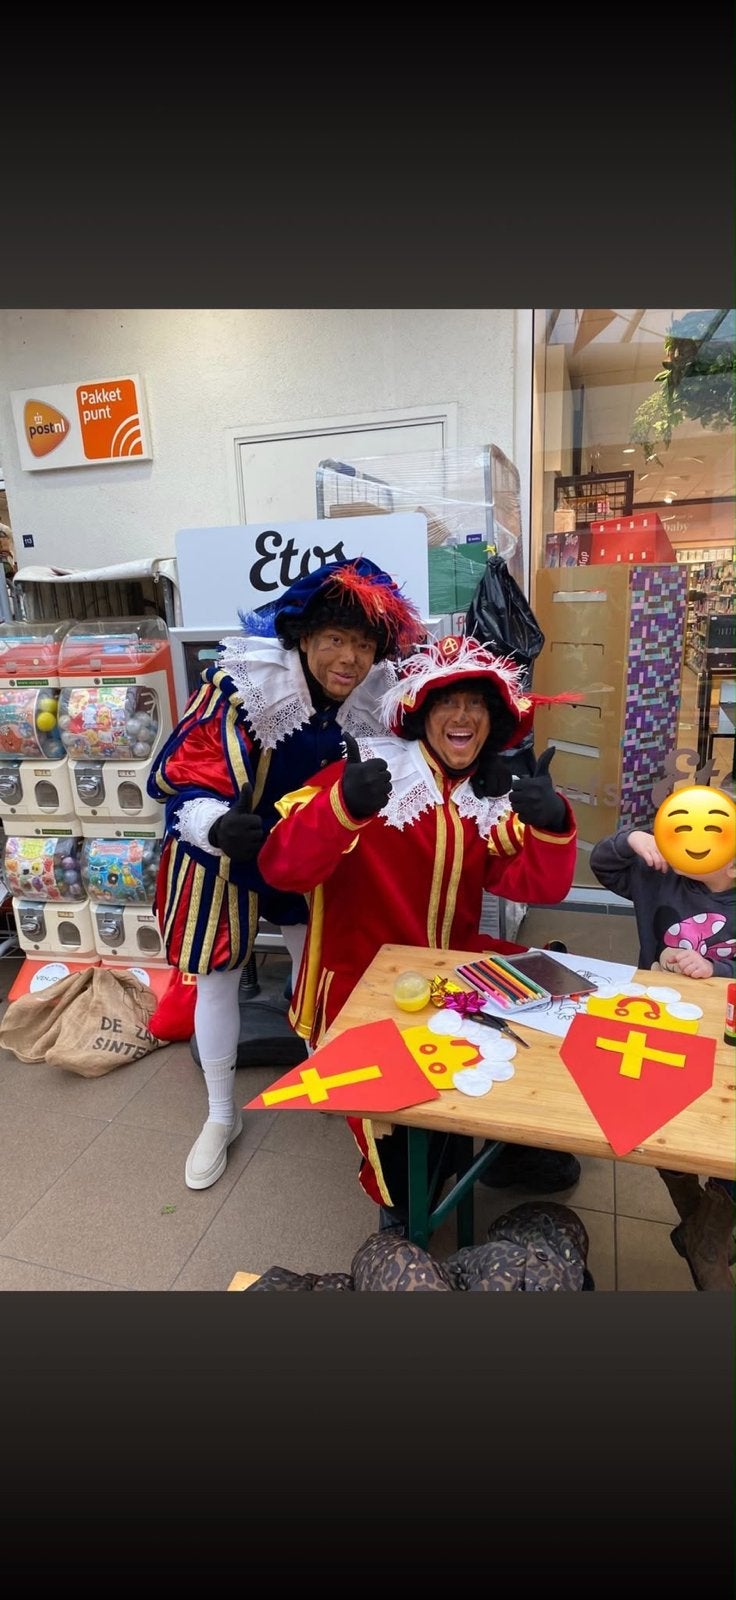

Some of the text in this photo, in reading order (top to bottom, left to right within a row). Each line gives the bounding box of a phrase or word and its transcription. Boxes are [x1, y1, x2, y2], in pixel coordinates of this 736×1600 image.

[80, 387, 122, 405] Pakket
[83, 405, 111, 424] punt
[29, 418, 65, 438] postnl
[100, 1016, 123, 1033] DE
[92, 1037, 151, 1060] SINTE
